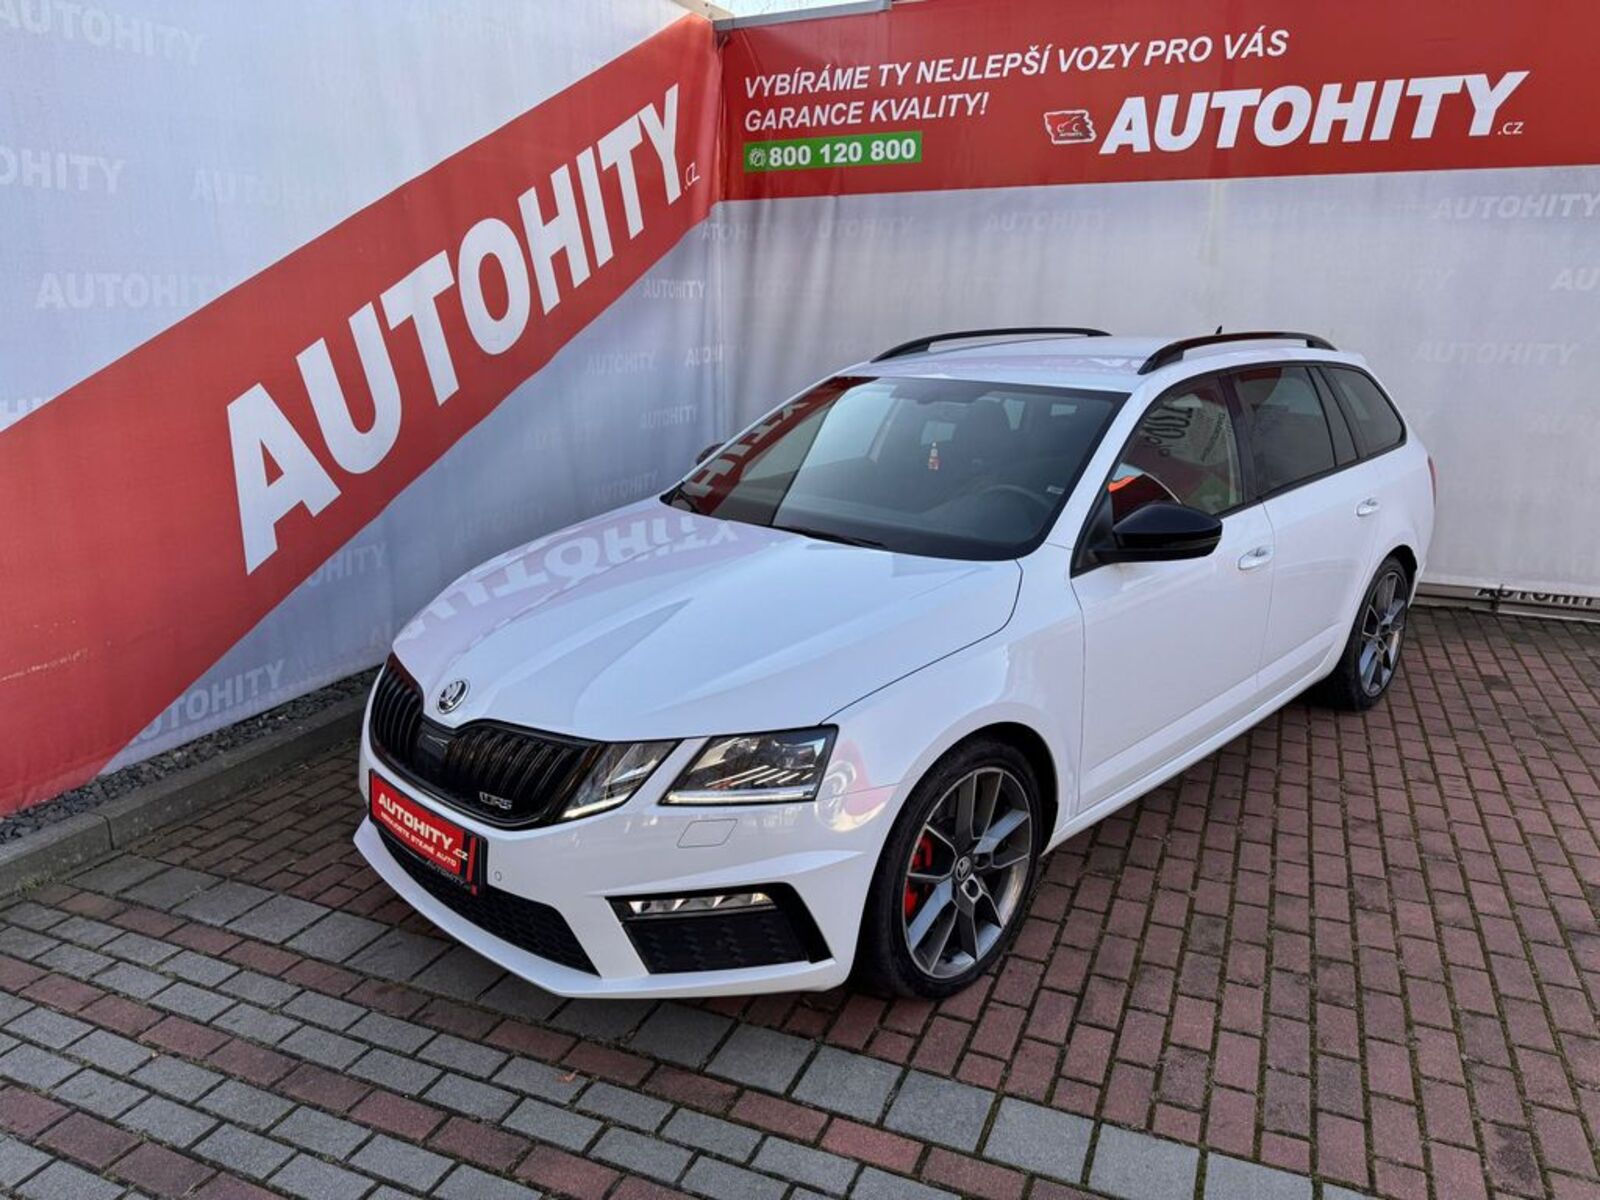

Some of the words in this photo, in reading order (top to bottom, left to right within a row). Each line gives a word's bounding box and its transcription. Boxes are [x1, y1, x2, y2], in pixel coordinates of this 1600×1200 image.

[745, 64, 870, 98] VYBÍRÁME
[879, 62, 911, 87] TY
[915, 43, 1052, 84] NEJLEPŠÍ
[1058, 41, 1140, 73] VOZY
[1144, 36, 1212, 66] PRO
[1223, 24, 1289, 60] VÁS
[745, 101, 864, 132] GARANCE
[870, 92, 989, 123] KVALITY!
[768, 144, 812, 167] 800
[820, 141, 863, 164] 120
[871, 137, 917, 161] 800
[378, 792, 454, 850] AUTOHITY
